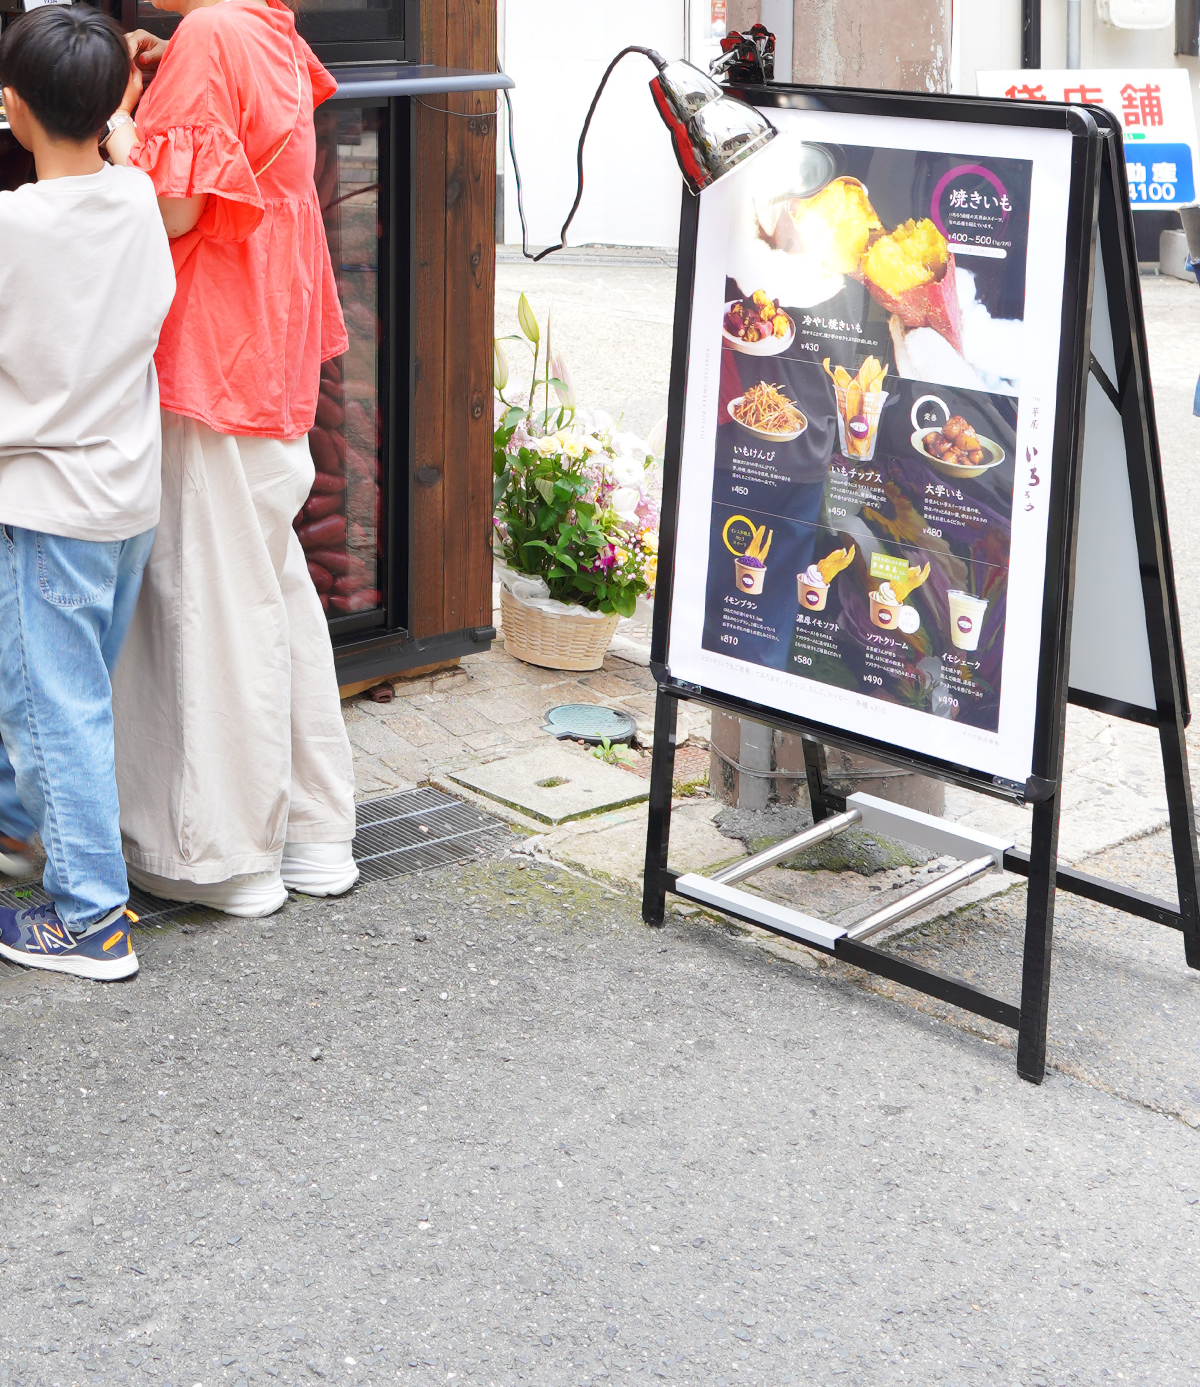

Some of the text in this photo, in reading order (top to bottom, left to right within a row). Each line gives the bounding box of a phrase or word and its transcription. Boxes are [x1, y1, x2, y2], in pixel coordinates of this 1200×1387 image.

[949, 188, 1013, 212] 焼きいも
[801, 314, 863, 334] 冷やし焼きいも
[830, 462, 883, 485] いもチップス
[924, 481, 964, 502] 大学いも
[922, 525, 942, 538] ¥480
[723, 593, 758, 612] イモンブラン
[719, 632, 739, 647] ¥810
[865, 631, 909, 651] ソフトクリーム
[792, 652, 813, 667] ¥580
[940, 651, 981, 671] イモシェーク
[862, 672, 883, 687] ¥490
[937, 693, 959, 708] ¥490
